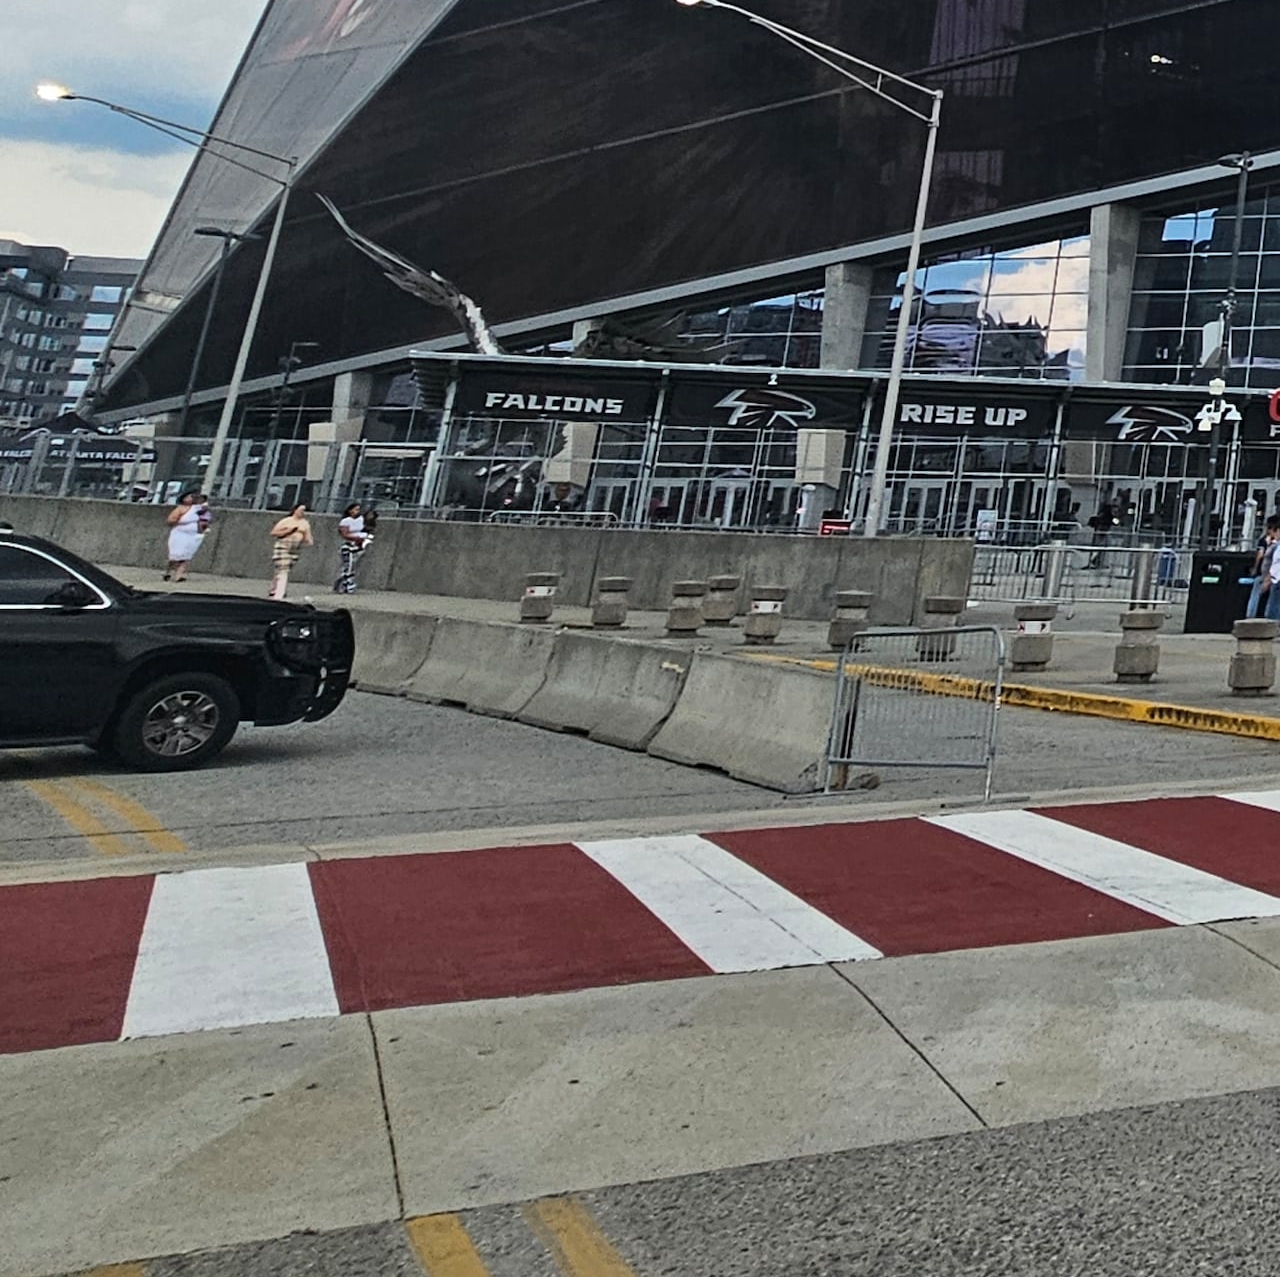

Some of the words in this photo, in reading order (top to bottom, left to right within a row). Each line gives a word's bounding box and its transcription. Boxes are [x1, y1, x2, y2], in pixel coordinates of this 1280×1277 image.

[485, 392, 624, 414] FALCONS
[900, 404, 977, 425] RISE
[984, 407, 1028, 426] UP
[105, 452, 155, 460] FALCNS
